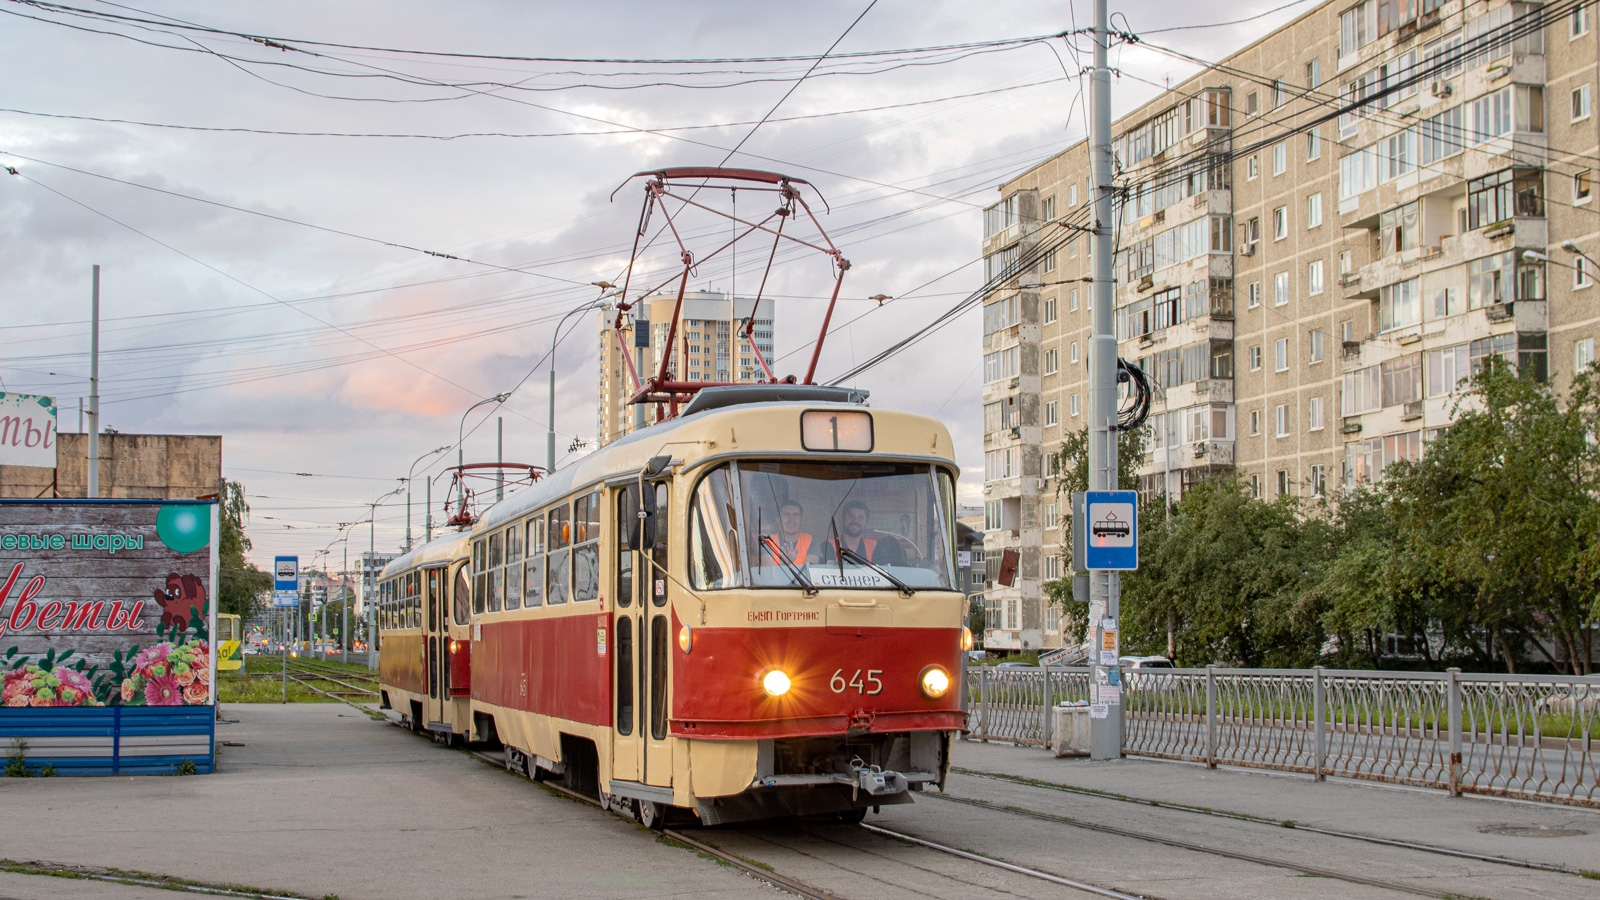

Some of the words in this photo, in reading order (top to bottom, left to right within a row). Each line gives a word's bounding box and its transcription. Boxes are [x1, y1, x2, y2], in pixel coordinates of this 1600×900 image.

[829, 416, 839, 451] 1
[0, 534, 65, 550] евые
[71, 534, 144, 555] шары
[747, 610, 773, 621] ЕМУП
[829, 668, 884, 696] 645
